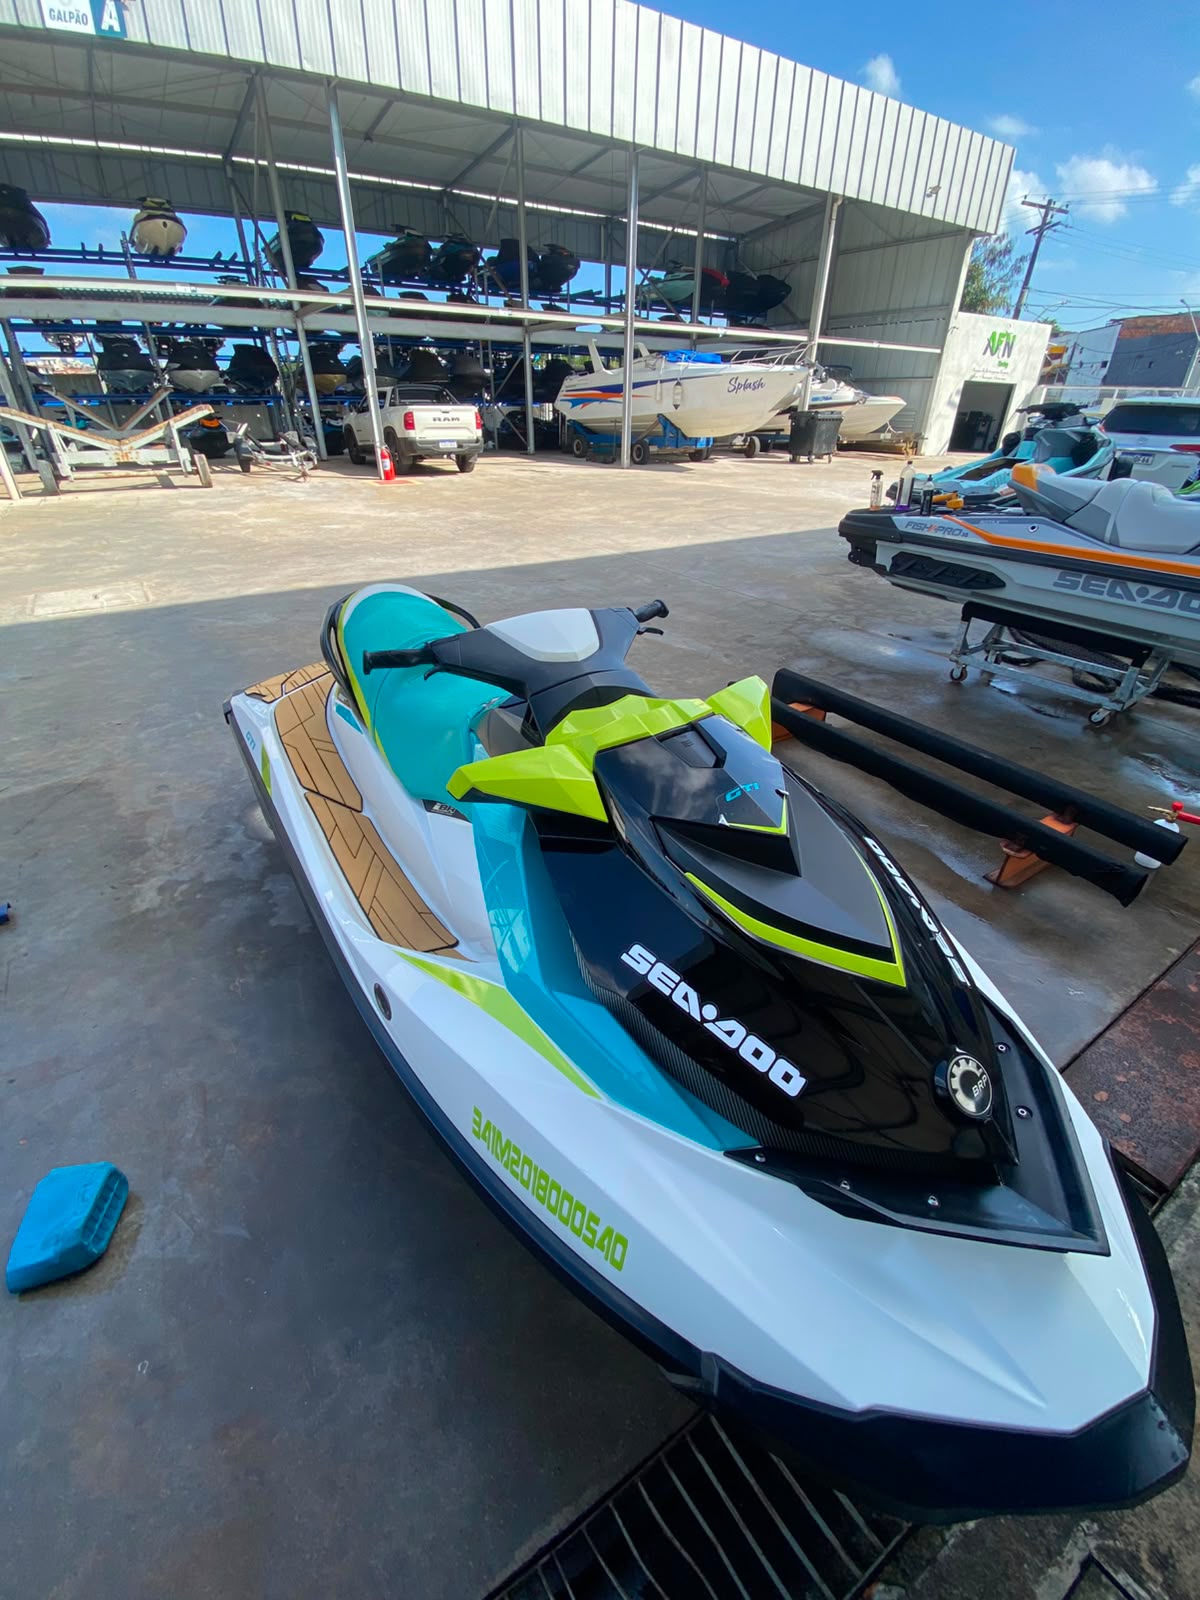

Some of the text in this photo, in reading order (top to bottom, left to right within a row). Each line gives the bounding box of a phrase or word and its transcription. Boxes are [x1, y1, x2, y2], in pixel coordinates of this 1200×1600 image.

[49, 0, 121, 32] GALPÃO A
[727, 376, 766, 394] Splash
[972, 1074, 988, 1098] BRP
